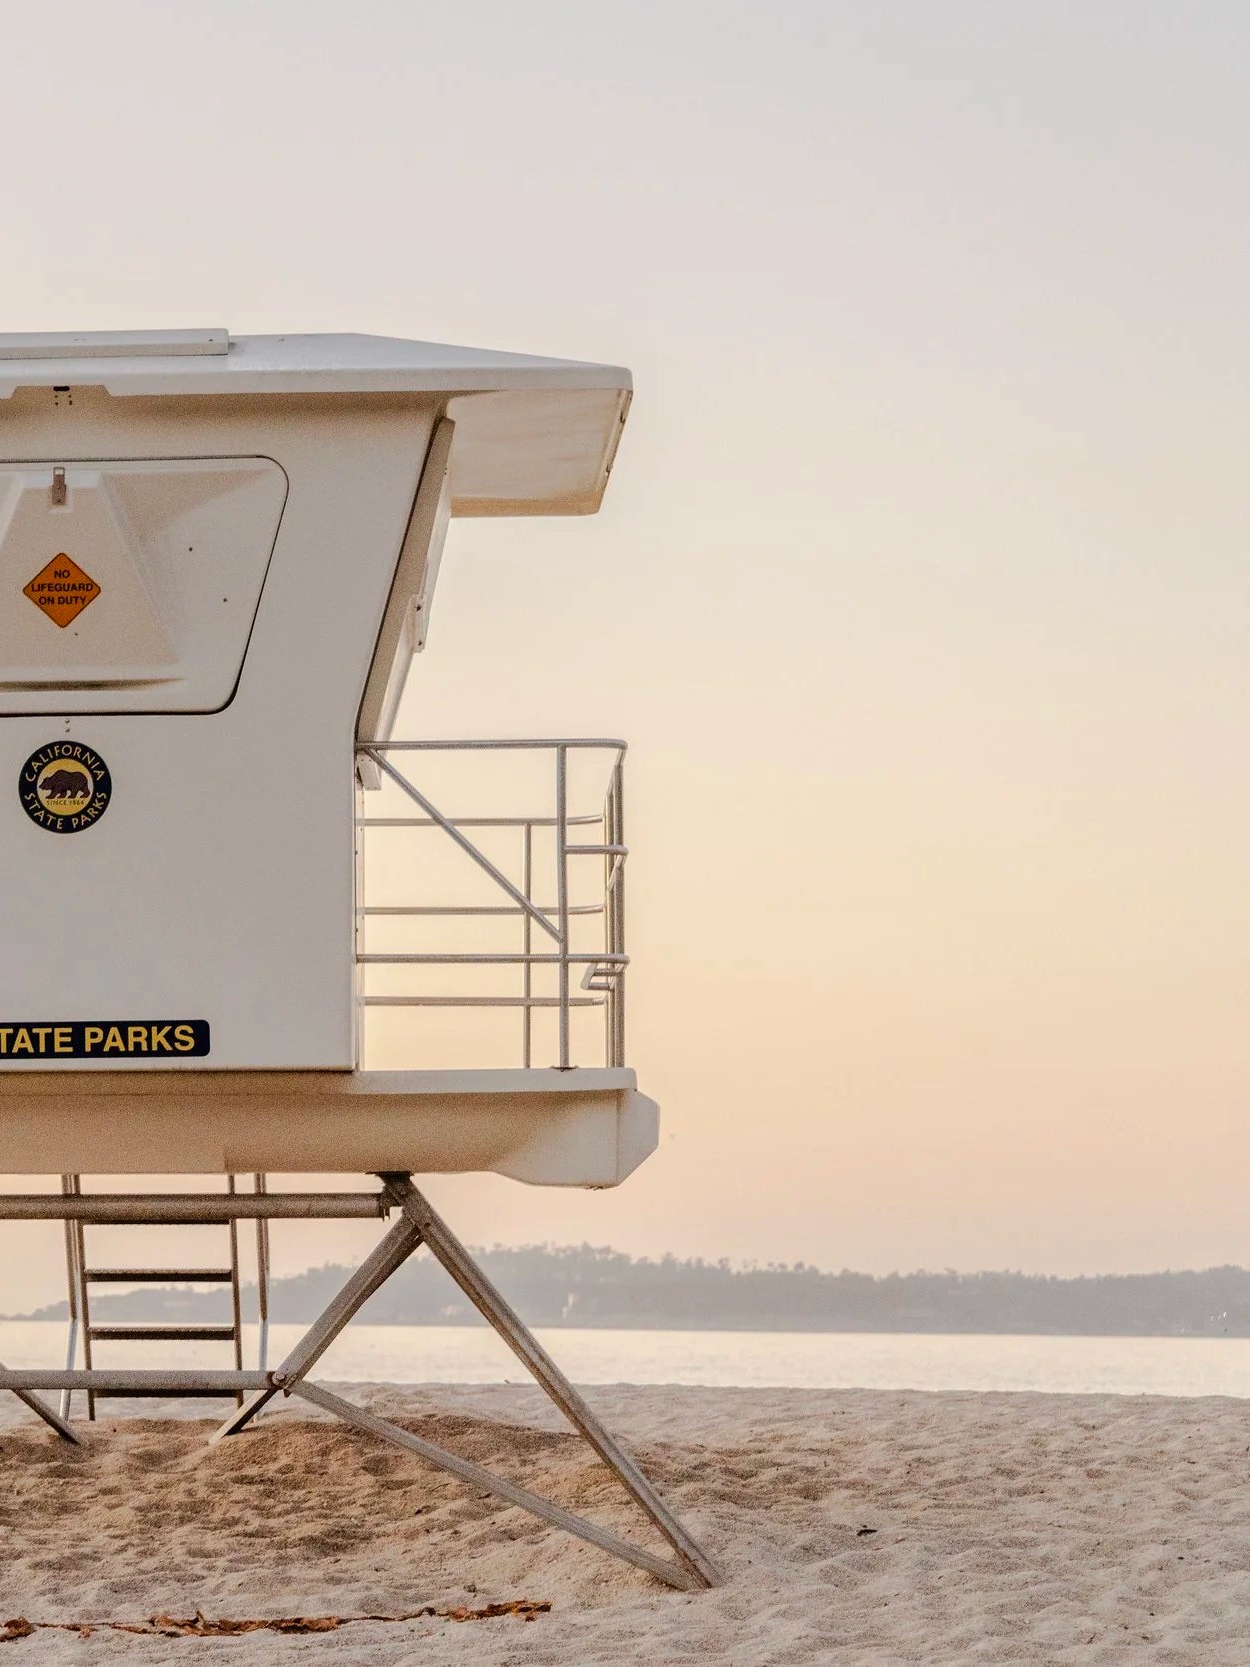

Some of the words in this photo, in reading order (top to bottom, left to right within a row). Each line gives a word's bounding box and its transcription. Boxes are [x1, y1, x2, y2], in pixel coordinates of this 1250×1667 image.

[54, 569, 71, 579] NO
[31, 583, 94, 592] LIFEGUARD
[38, 596, 55, 605] ON
[57, 596, 87, 605] DUTY
[25, 744, 105, 782] CALIFORNIA
[24, 792, 64, 830] STATE
[71, 792, 107, 829] PARKS
[84, 1024, 196, 1052] PARKS
